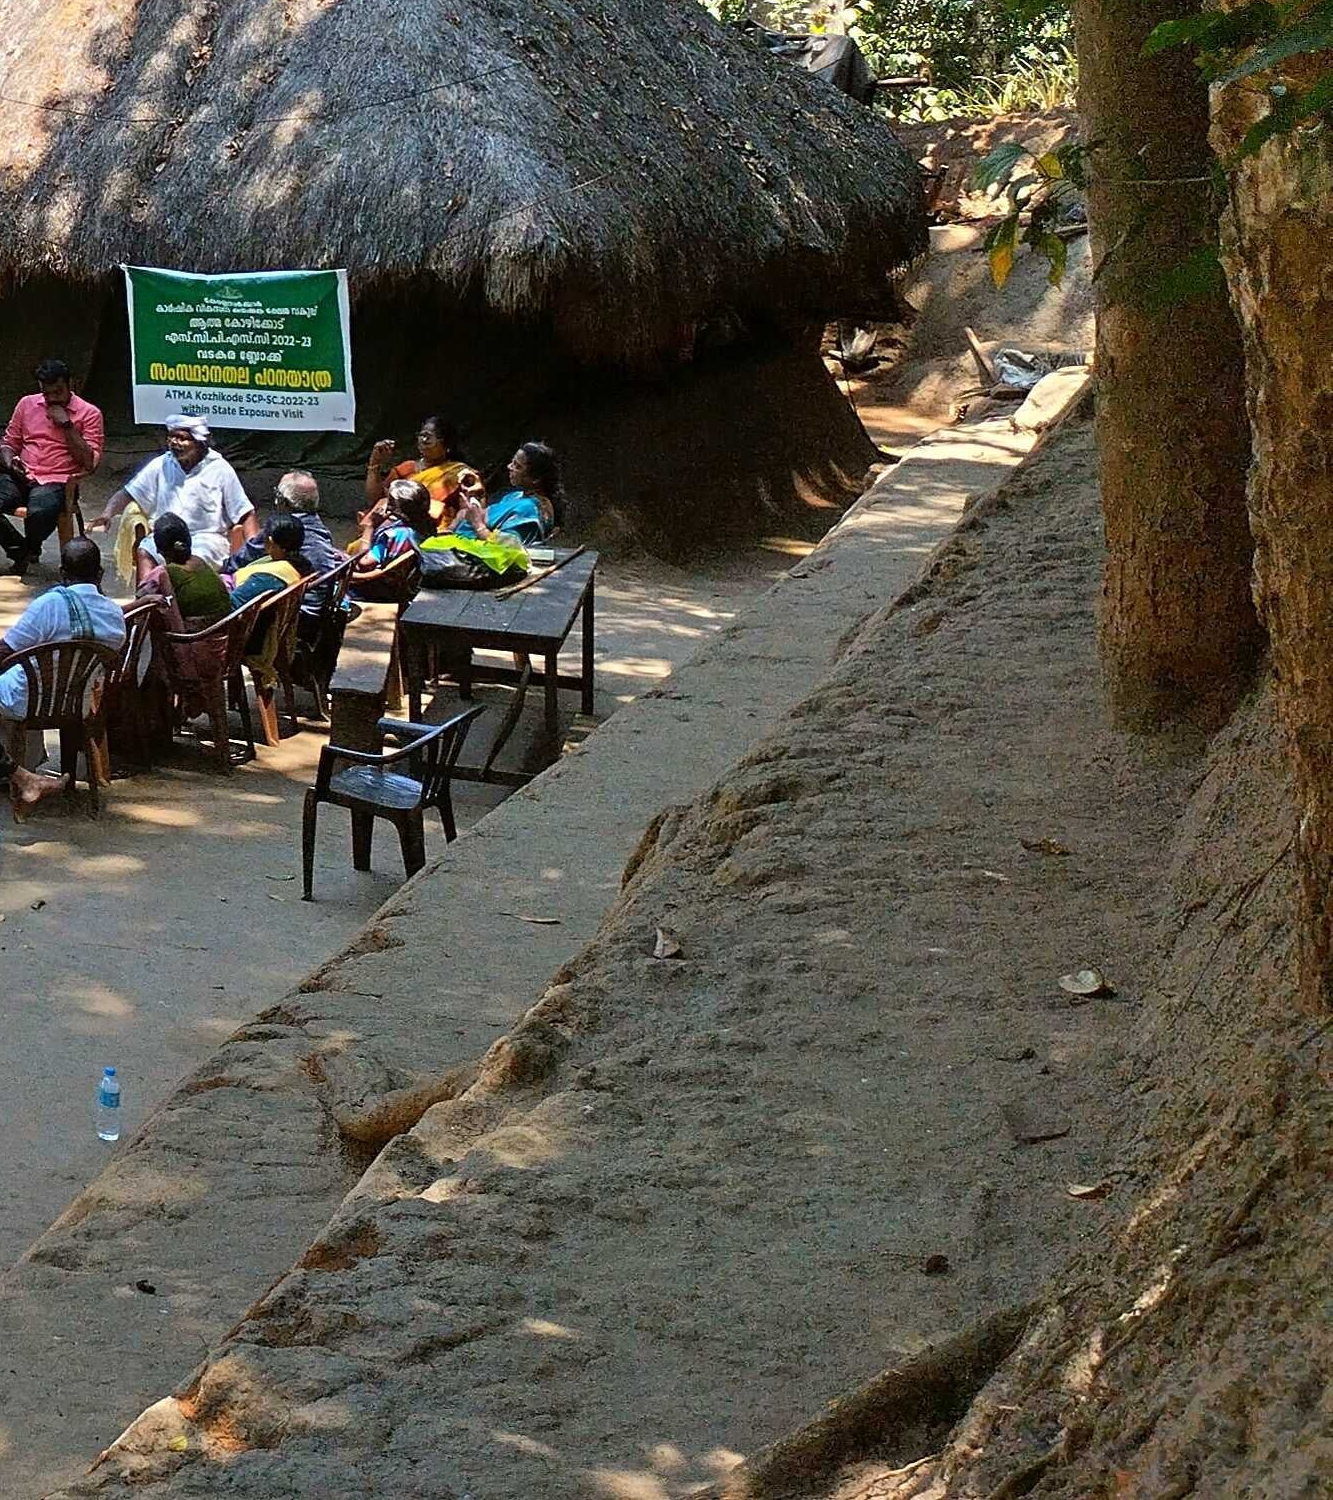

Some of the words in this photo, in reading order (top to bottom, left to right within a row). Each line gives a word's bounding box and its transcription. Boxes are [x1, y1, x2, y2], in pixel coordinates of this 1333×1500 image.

[224, 316, 285, 330] കോഴിക്കോട്
[196, 349, 236, 360] വടകര
[150, 362, 250, 385] സംസ്ഥാനതല
[255, 367, 332, 391] പഠനയാത്ര
[165, 389, 193, 400] ATMA
[196, 390, 244, 403] Kozhikode
[181, 403, 210, 414] within
[212, 404, 237, 415] State
[239, 407, 280, 419] Exposure
[282, 408, 304, 419] Visit
